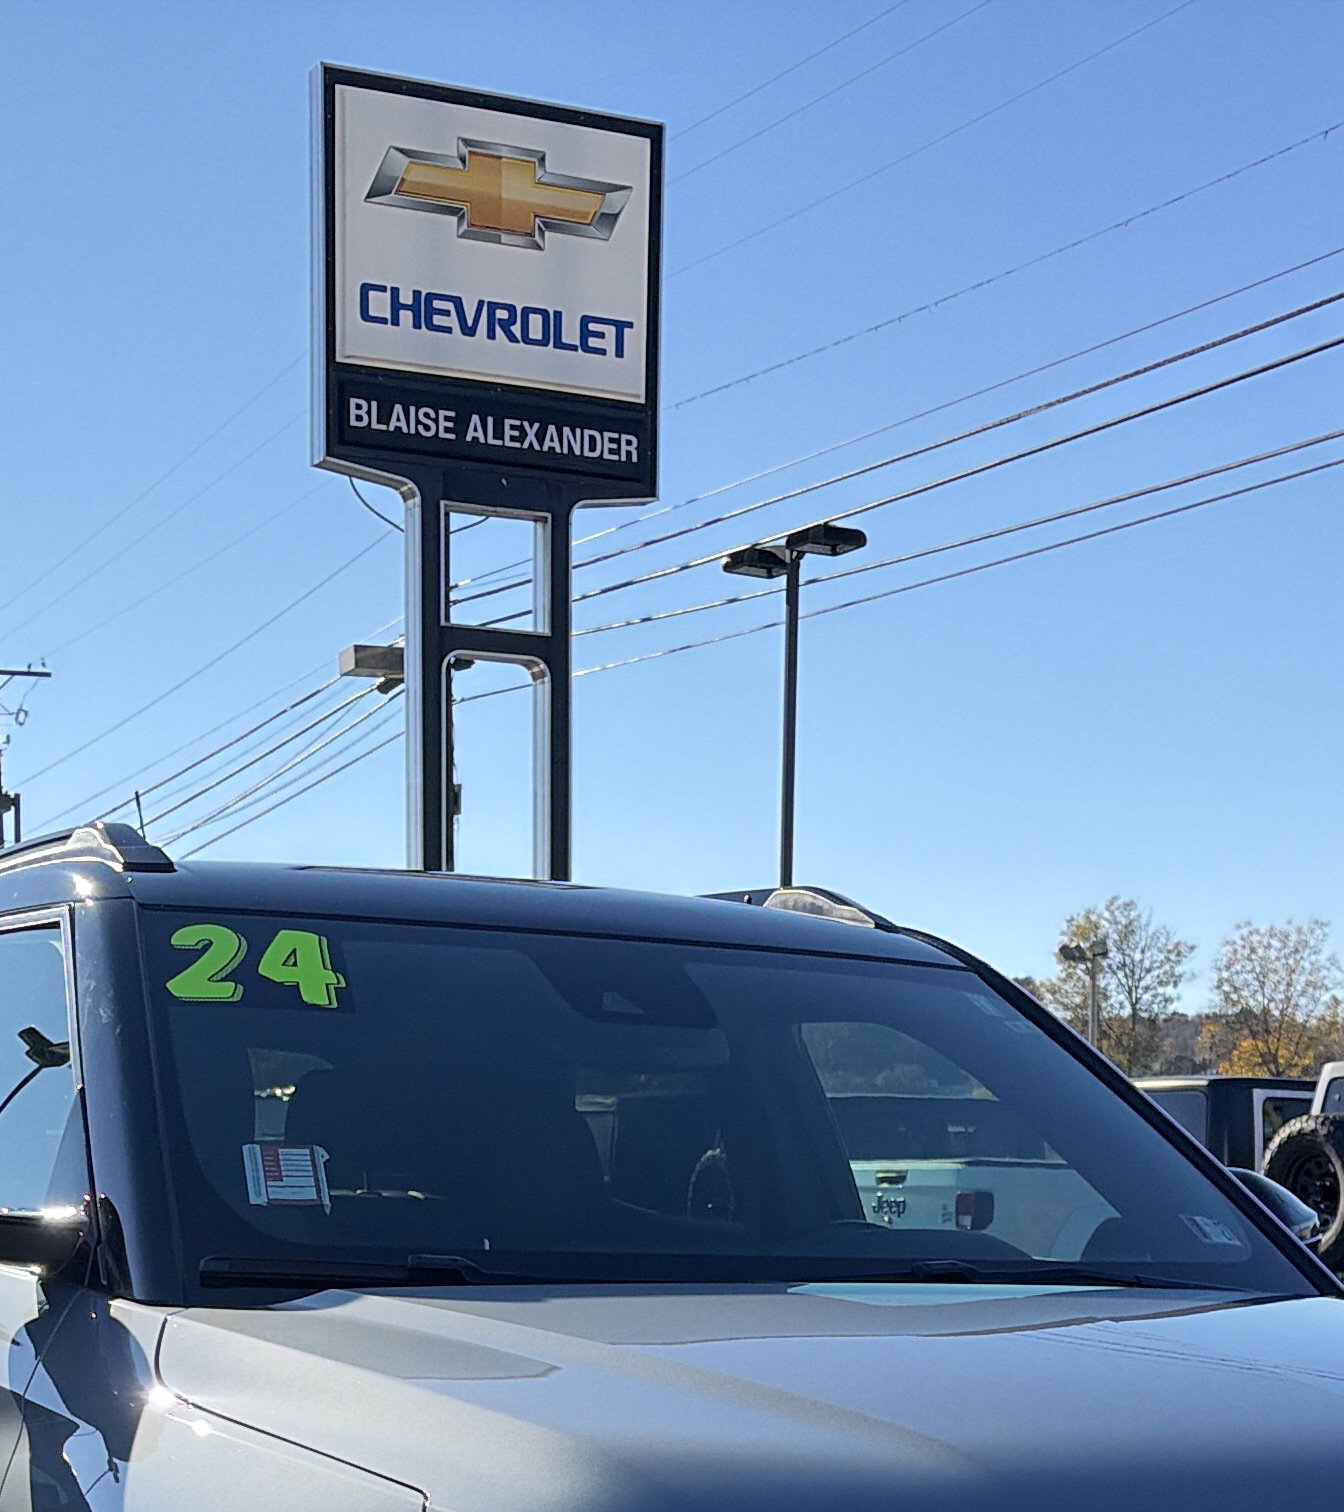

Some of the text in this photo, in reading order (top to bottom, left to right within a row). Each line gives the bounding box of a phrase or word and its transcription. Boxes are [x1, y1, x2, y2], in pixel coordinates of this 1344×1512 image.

[358, 281, 635, 359] CHEVROLET
[348, 396, 640, 463] BLAISE ALEXANDER
[165, 923, 347, 1009] 24
[871, 1191, 906, 1219] Jeep
